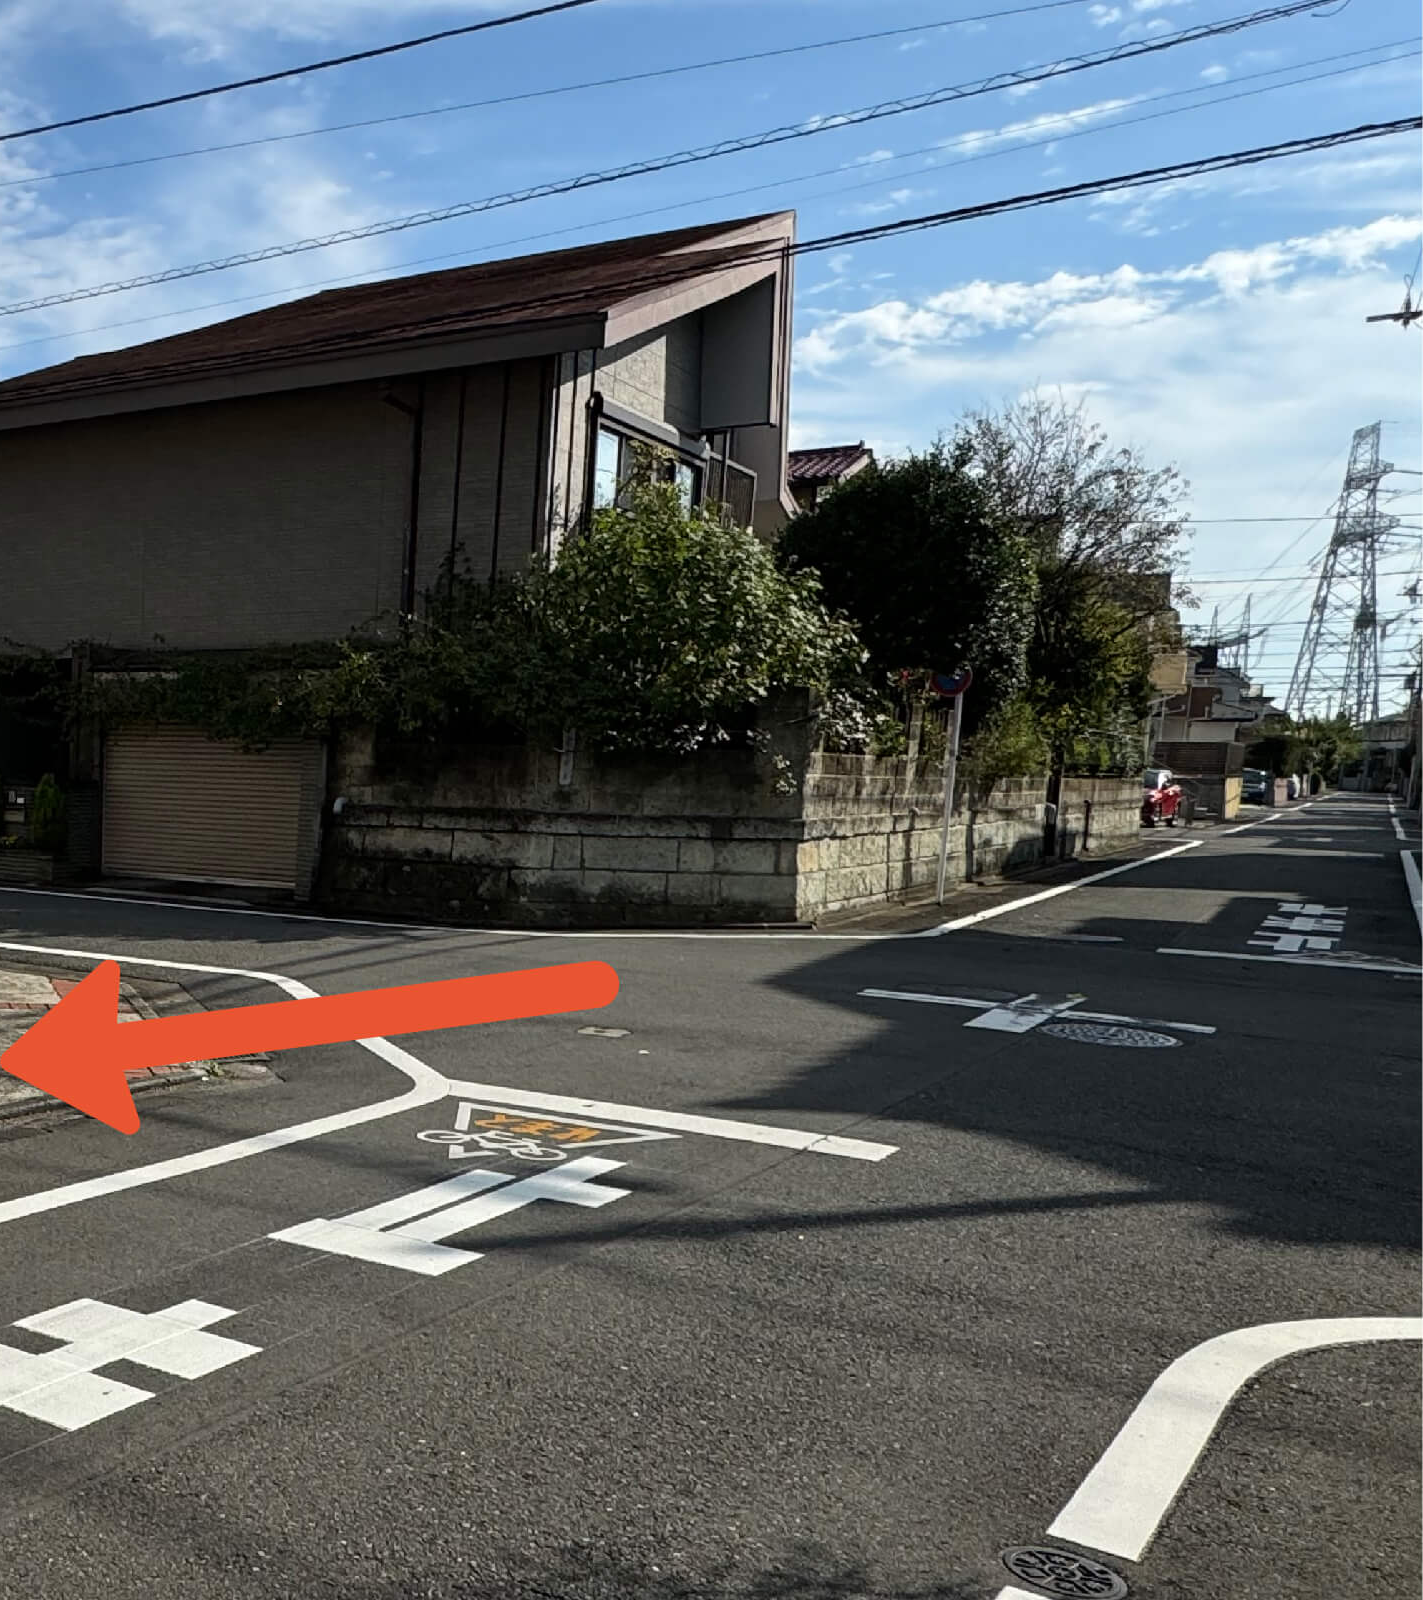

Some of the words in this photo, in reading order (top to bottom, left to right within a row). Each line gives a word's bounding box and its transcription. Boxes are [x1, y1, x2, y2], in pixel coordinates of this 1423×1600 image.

[1246, 902, 1349, 952] 止まれ
[475, 1112, 602, 1142] とまれ
